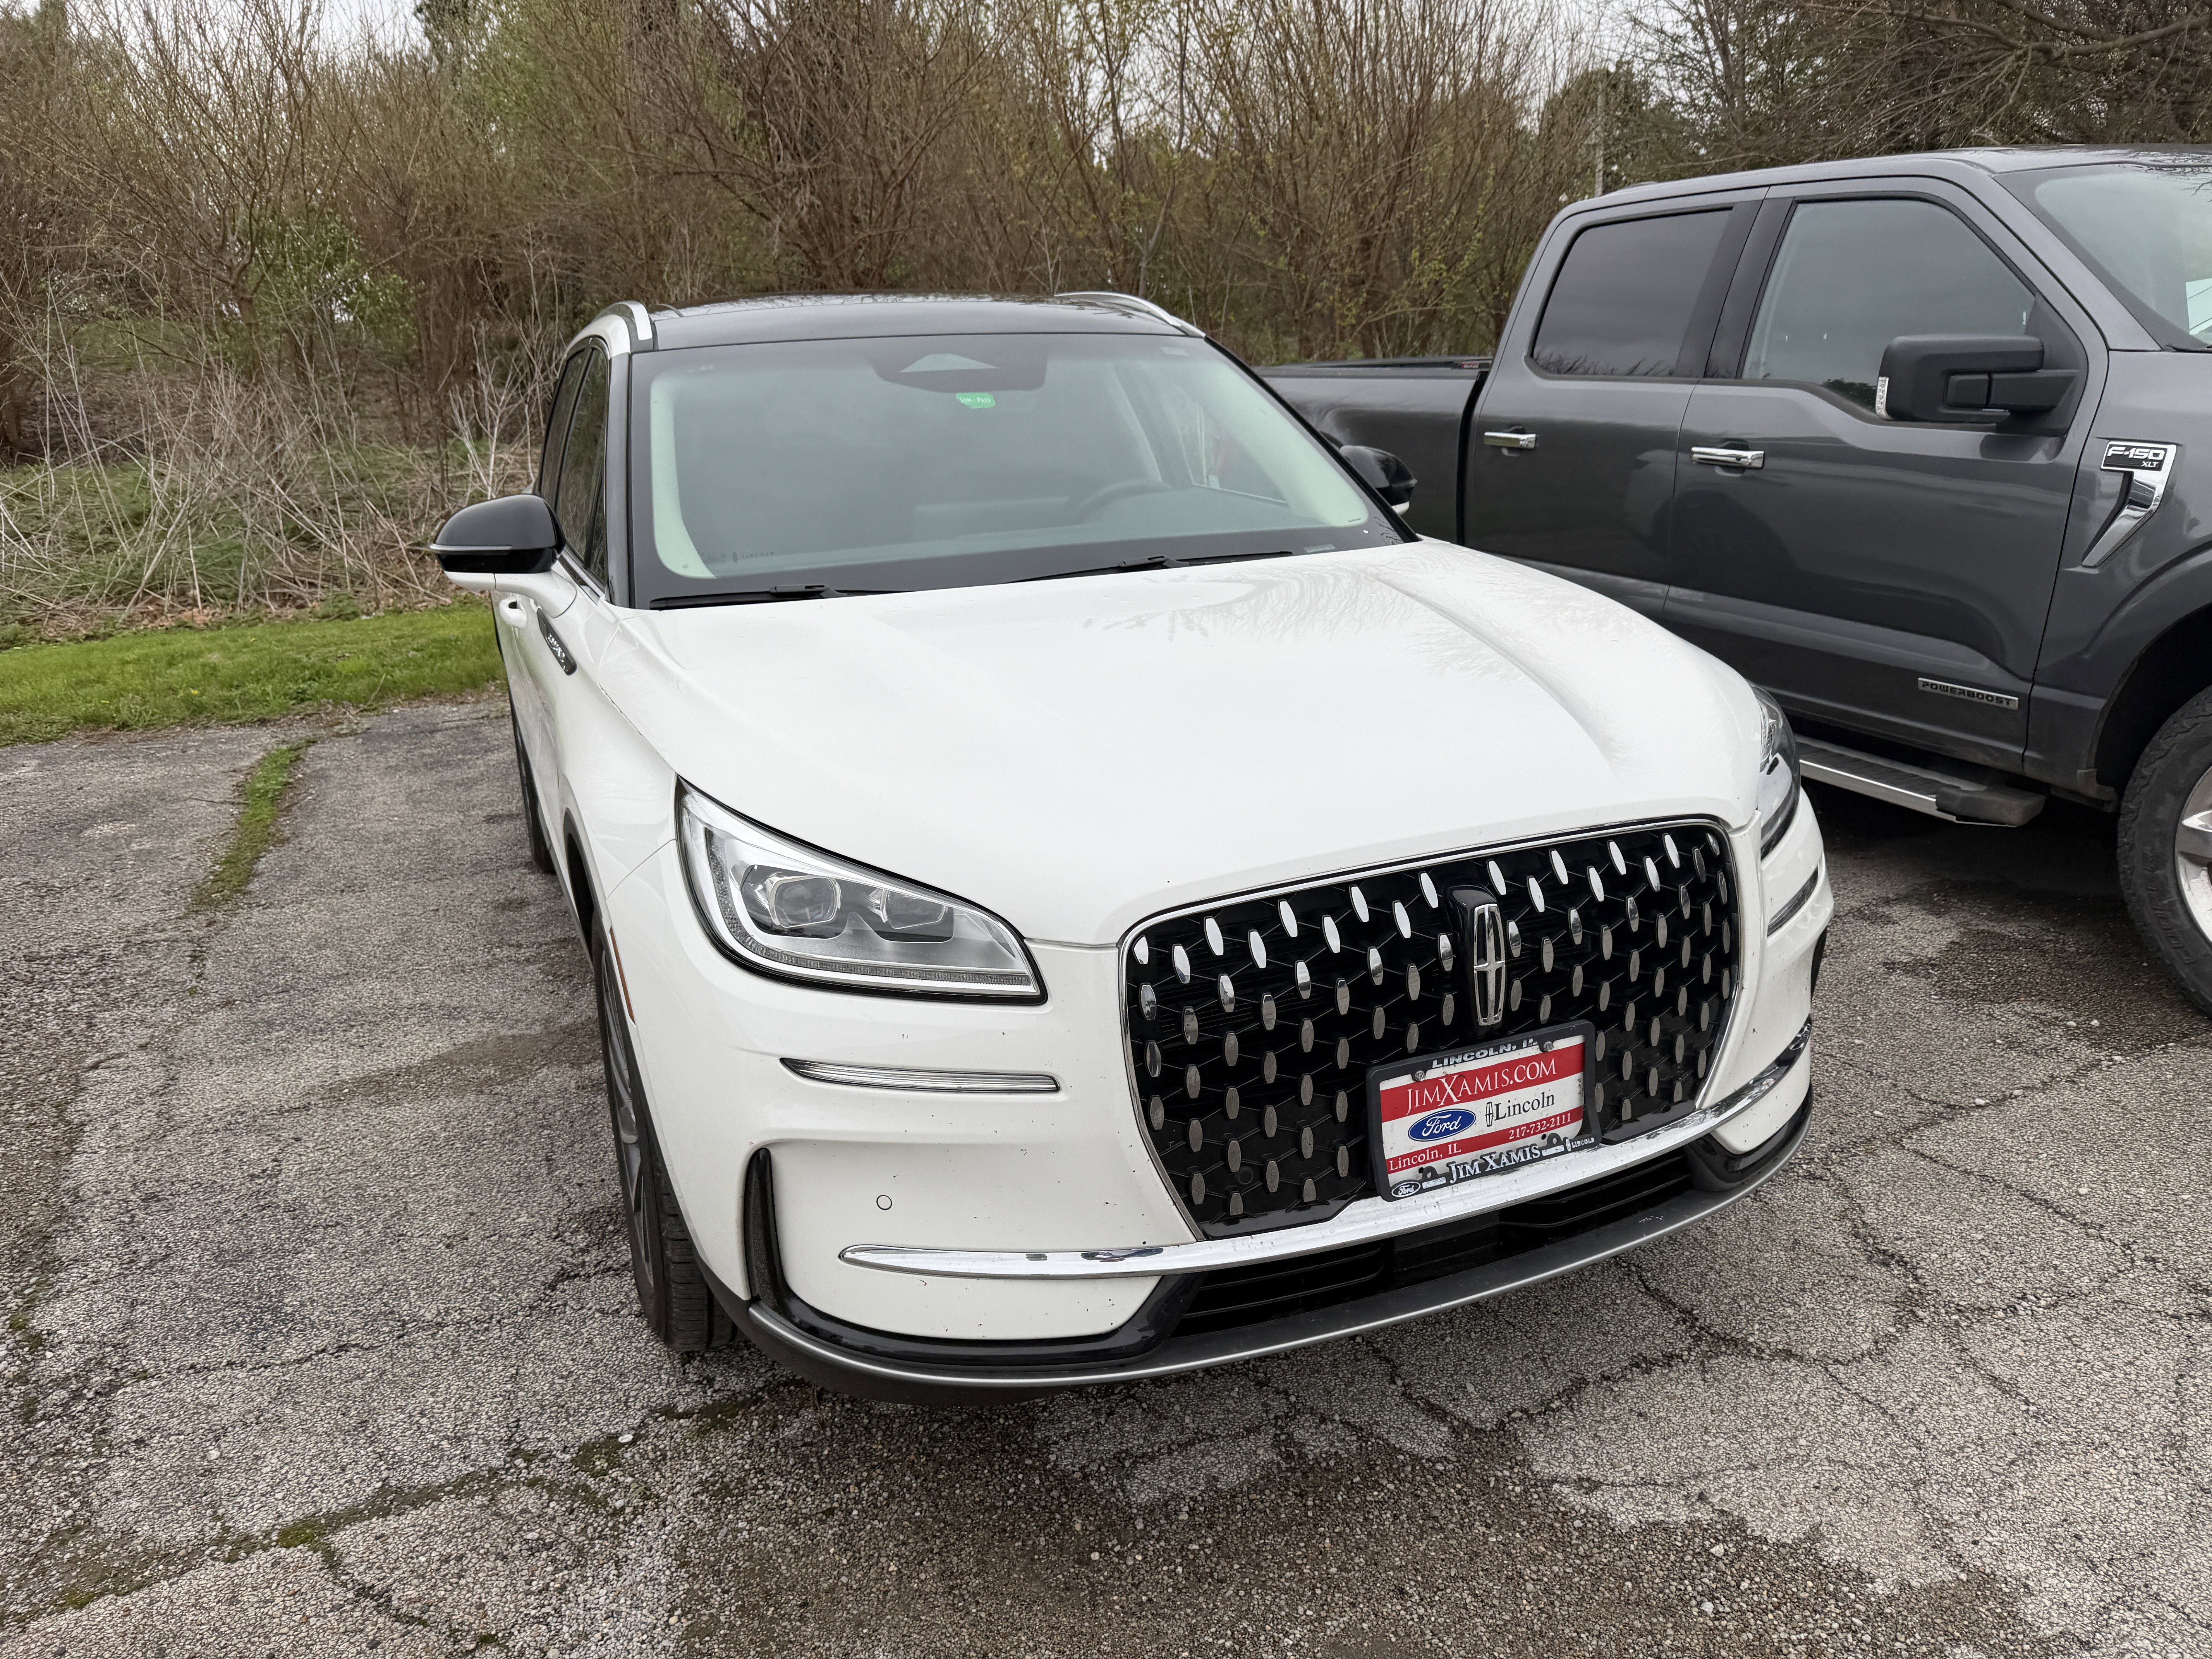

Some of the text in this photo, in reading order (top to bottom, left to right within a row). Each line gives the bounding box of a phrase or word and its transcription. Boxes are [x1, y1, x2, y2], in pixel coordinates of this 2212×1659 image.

[2107, 447, 2165, 460] F-150
[1922, 681, 2013, 706] POWERBOOST
[1432, 1038, 1538, 1068] LINCOLN, IL
[1494, 1091, 1555, 1121] Lincoln
[1422, 1114, 1462, 1137] Ford
[1509, 1113, 1571, 1140] 217-732-2111
[1389, 1143, 1462, 1171] Lincoln, IL
[1449, 1145, 1540, 1183] JIM XAMIS
[1398, 1184, 1415, 1195] Ford
